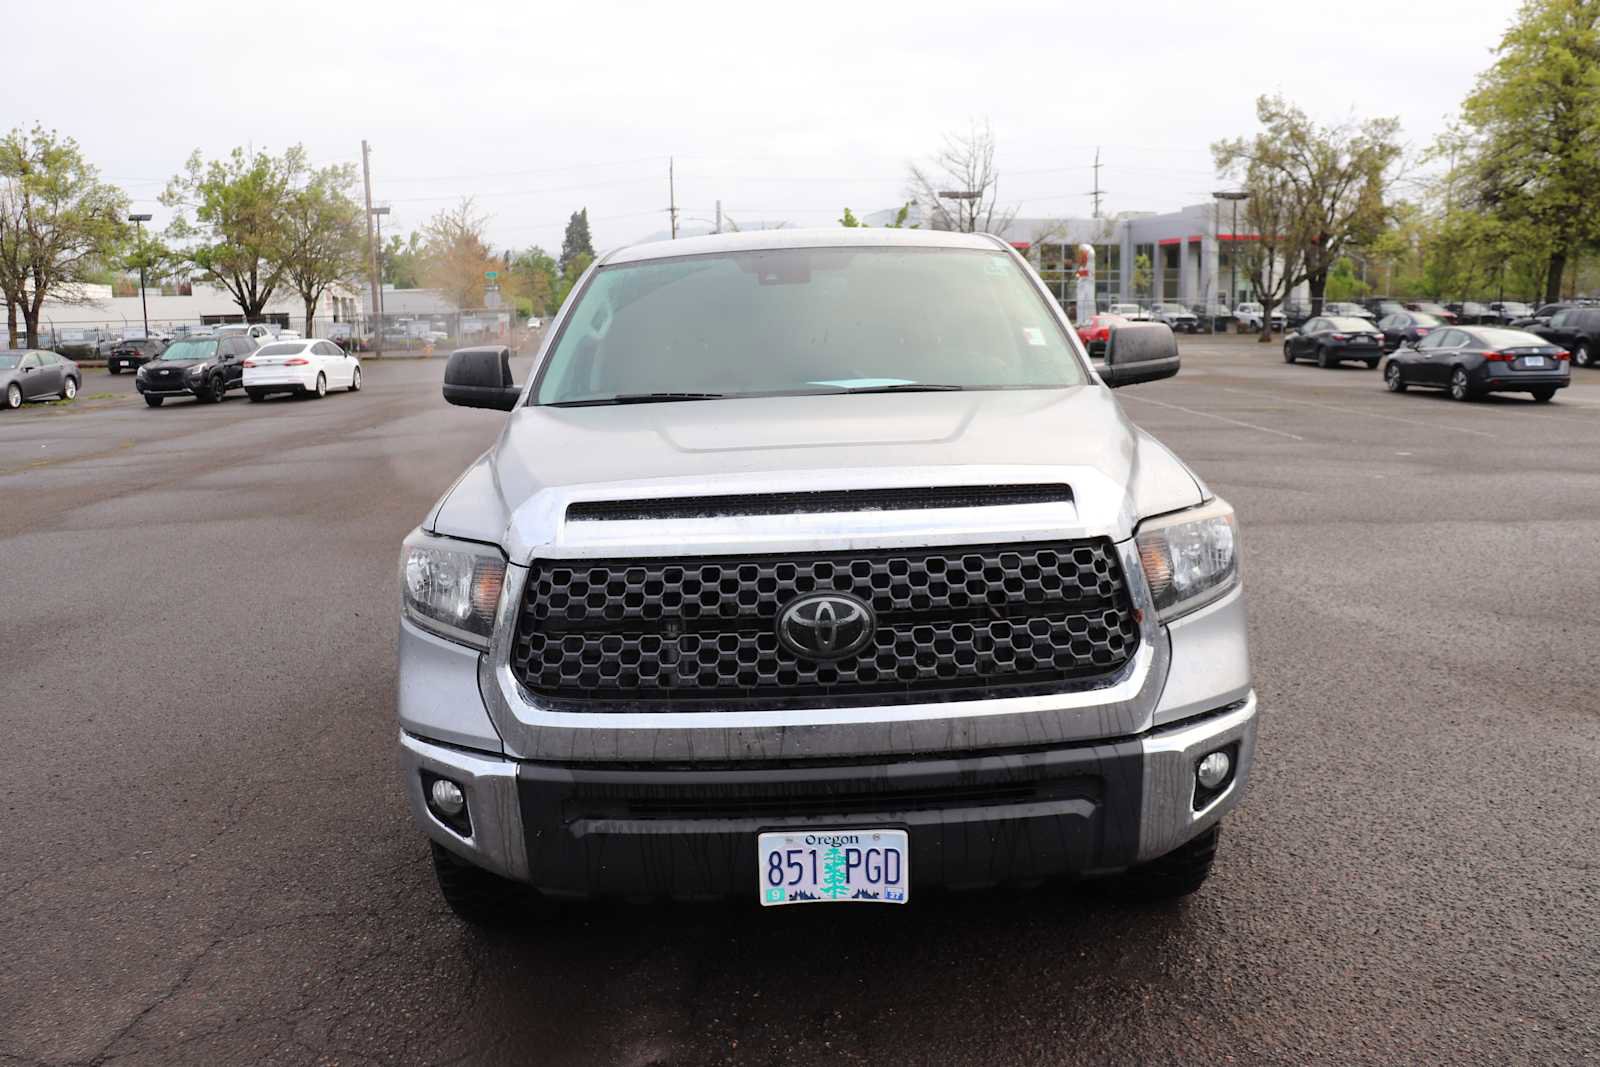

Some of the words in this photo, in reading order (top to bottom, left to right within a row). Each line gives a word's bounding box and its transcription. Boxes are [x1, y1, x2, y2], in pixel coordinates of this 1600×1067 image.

[805, 834, 859, 847] Oregon
[768, 850, 818, 886] 851
[845, 848, 901, 885] PGD
